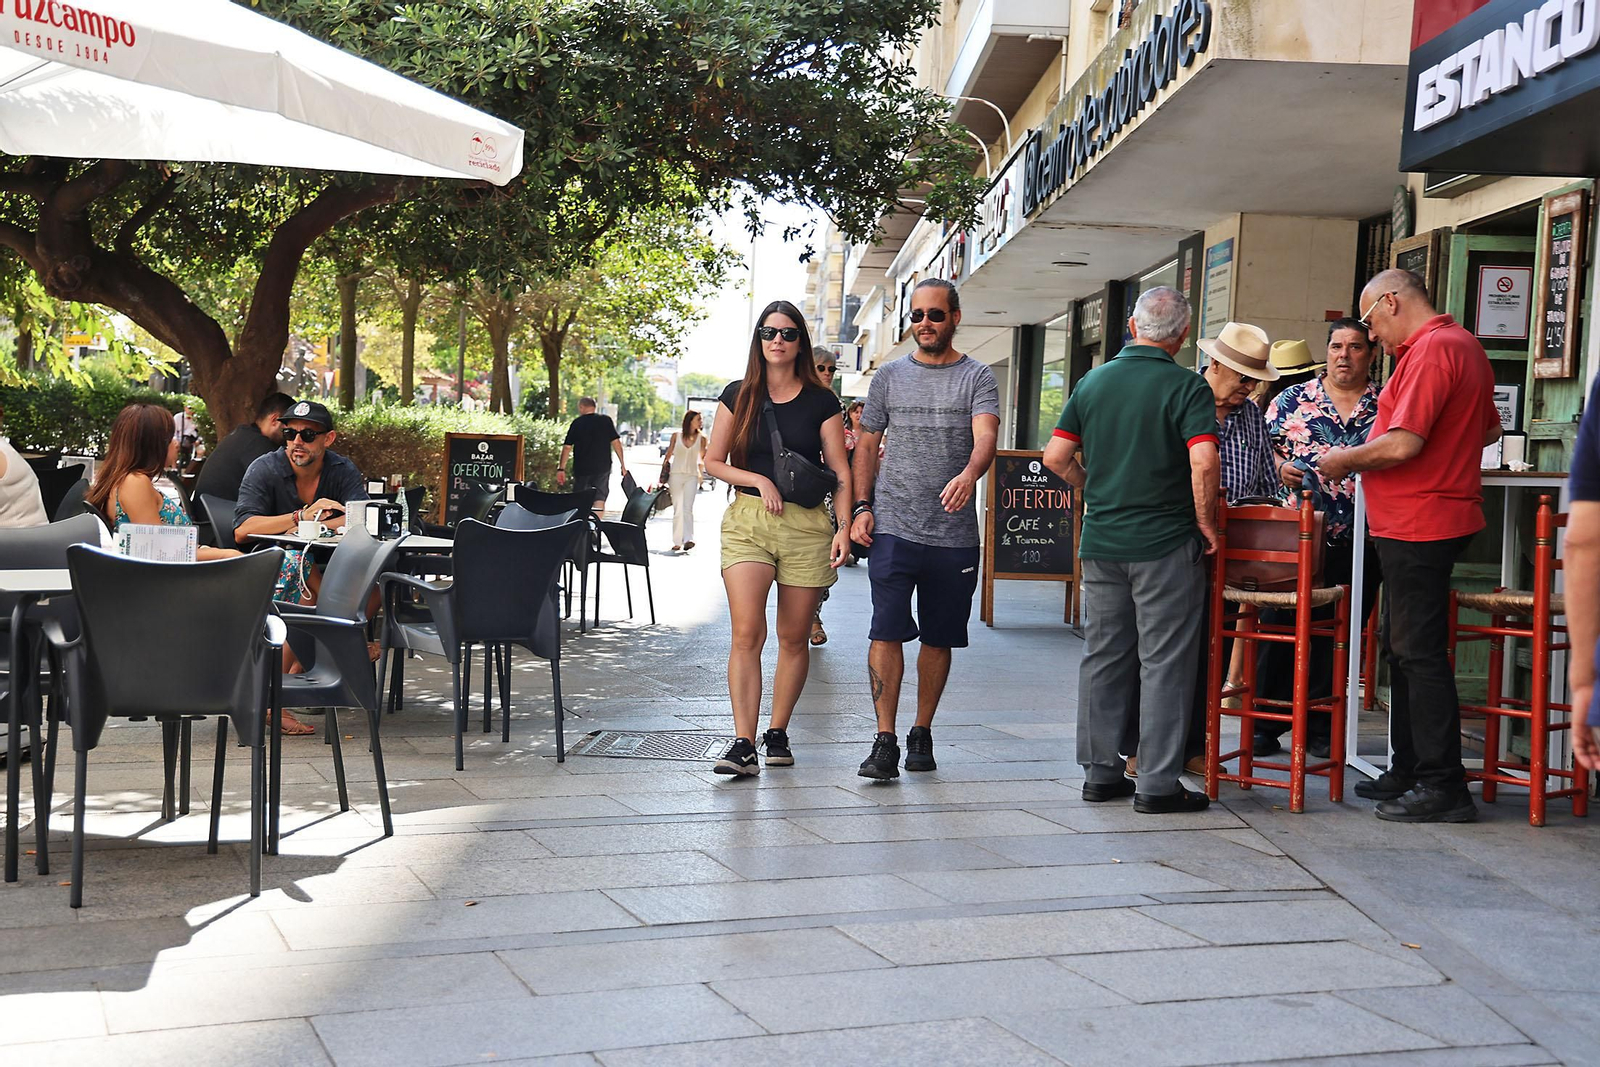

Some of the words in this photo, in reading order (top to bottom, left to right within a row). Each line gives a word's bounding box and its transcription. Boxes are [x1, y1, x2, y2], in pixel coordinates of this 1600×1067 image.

[14, 30, 64, 53] DESDE
[76, 43, 109, 64] 1904
[1413, 0, 1600, 132] ESTANCO
[468, 160, 501, 172] reciclado
[471, 453, 494, 461] BAZAR
[453, 463, 503, 478] OFERTÓN
[453, 477, 471, 490] PEL
[1021, 475, 1048, 483] BAZAR
[1006, 514, 1041, 532] CAFÉ
